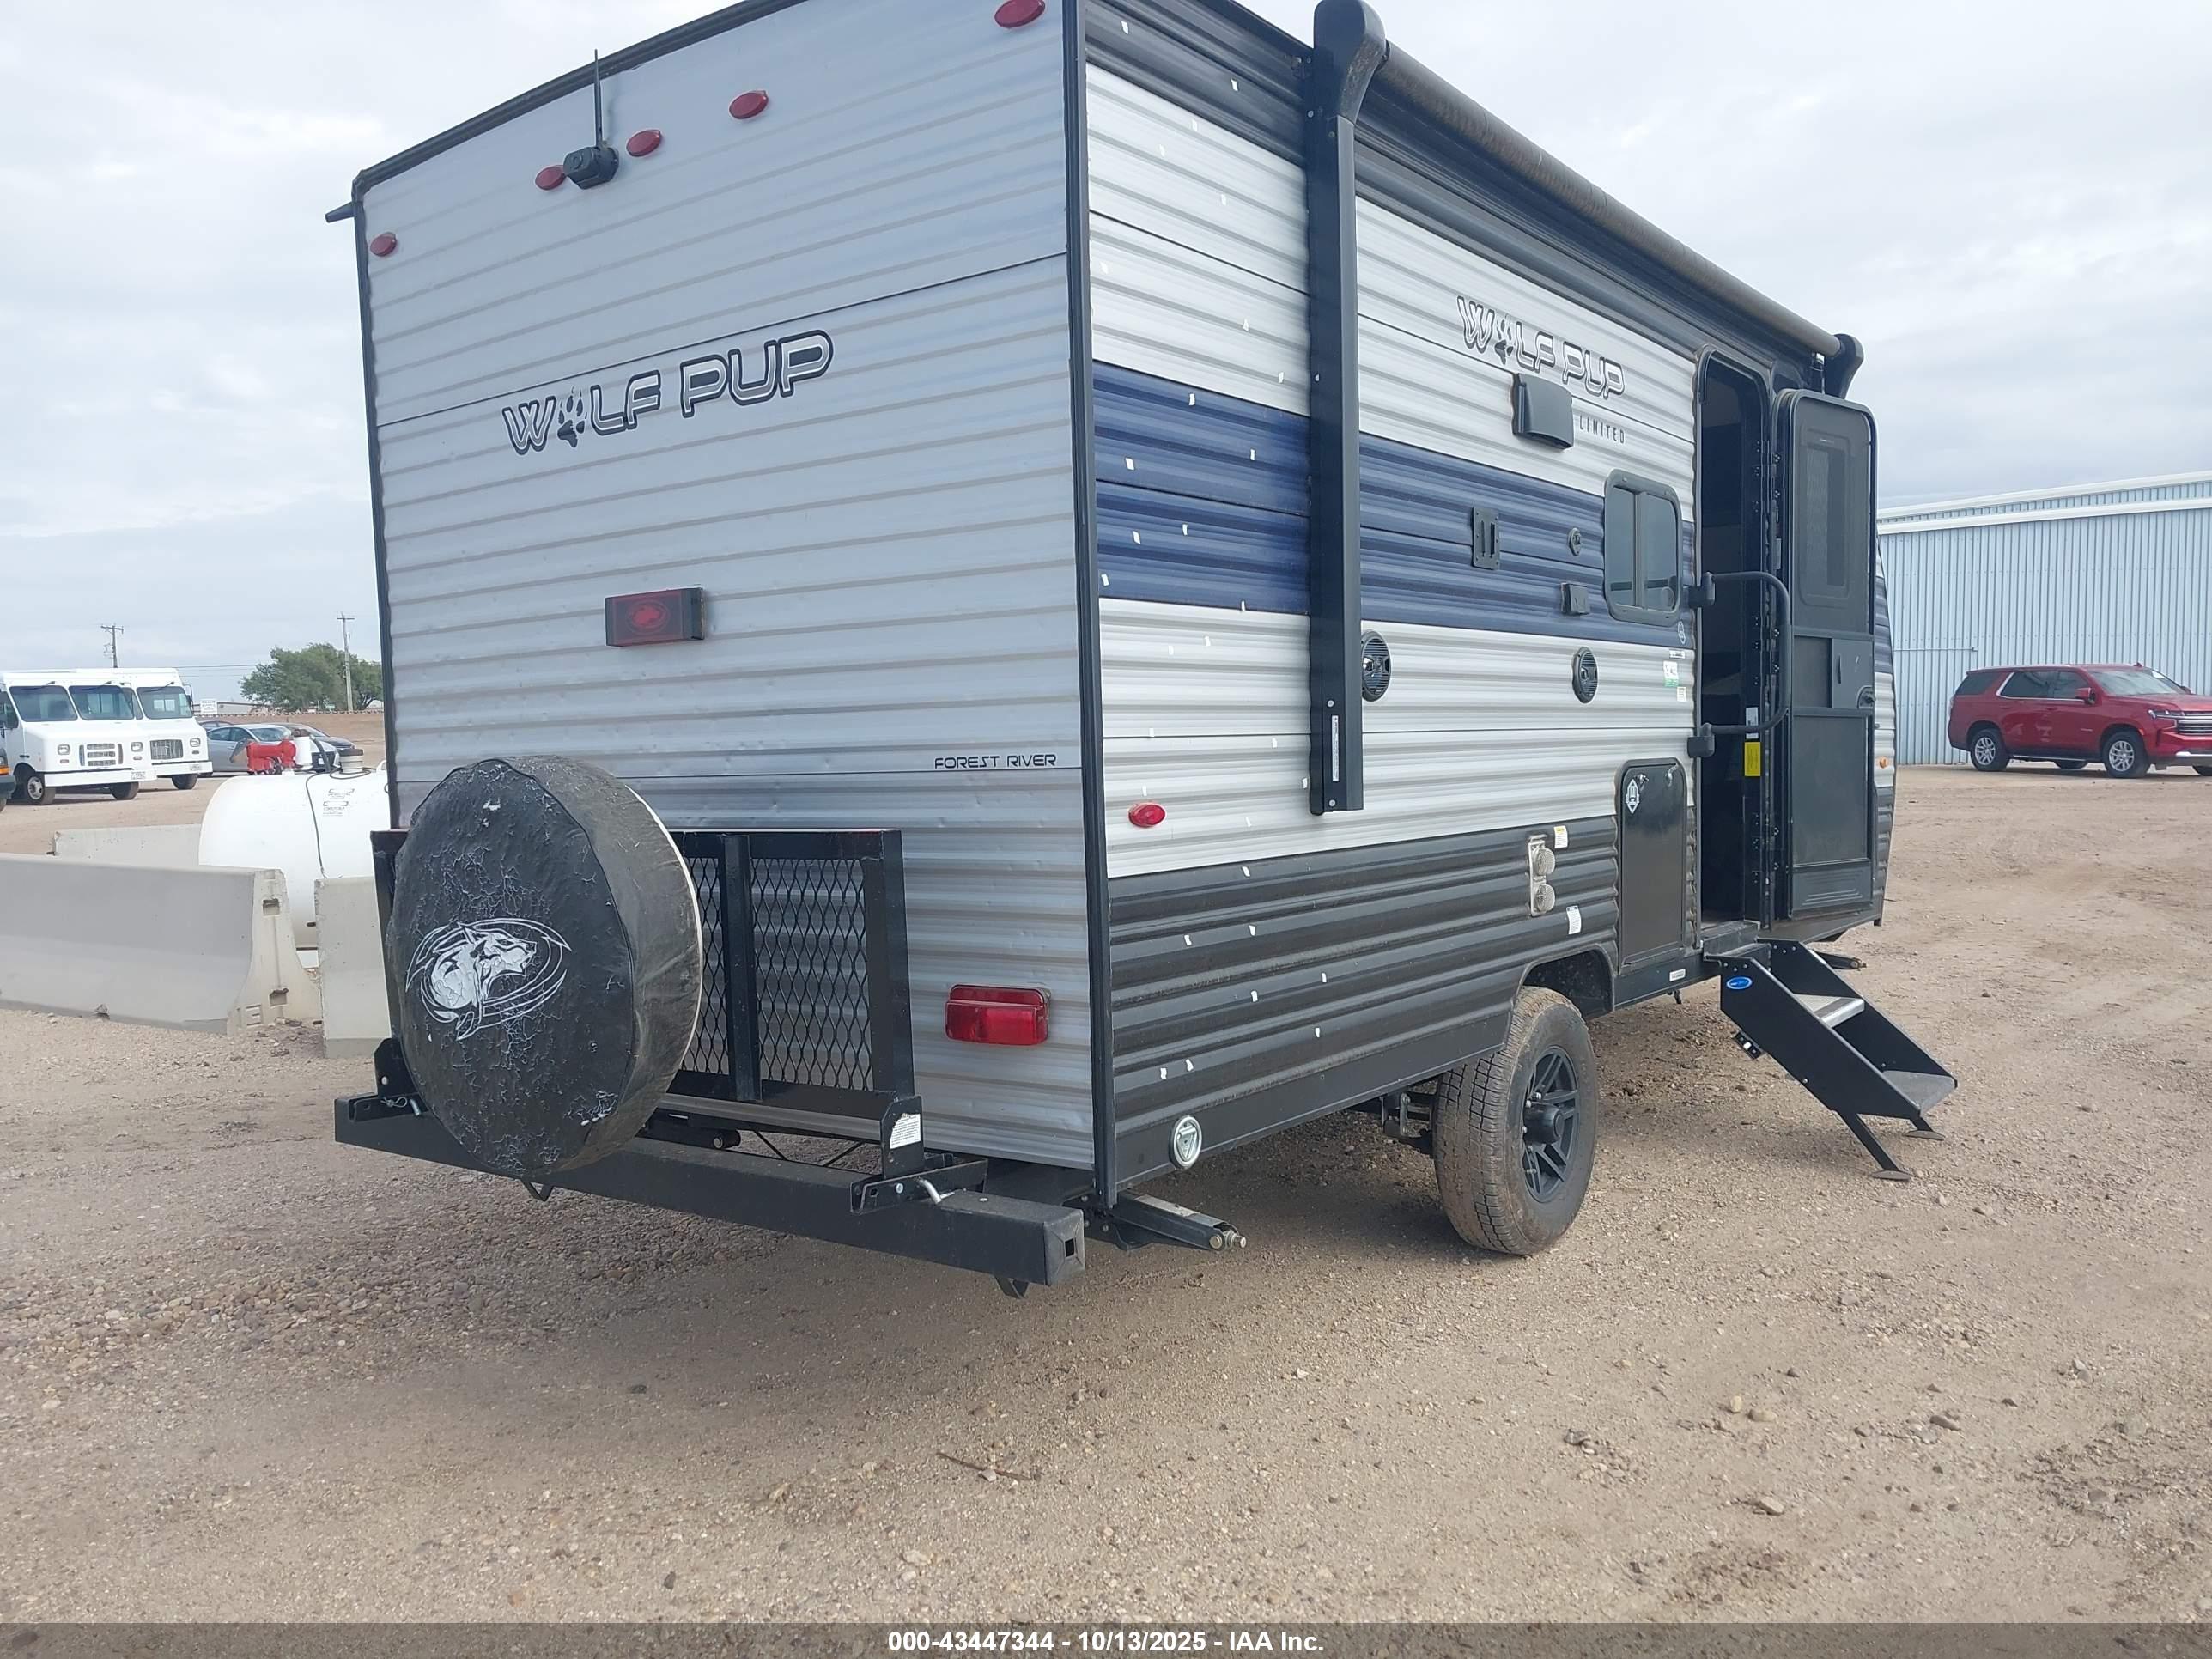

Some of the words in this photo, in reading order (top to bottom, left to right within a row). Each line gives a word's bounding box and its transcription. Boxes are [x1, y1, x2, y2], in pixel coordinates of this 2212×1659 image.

[1456, 295, 1556, 374] WLF
[1562, 340, 1626, 400] PUP
[501, 369, 660, 456] WLF
[679, 329, 834, 418] PUP
[1579, 415, 1625, 444] LIMITED
[934, 756, 1000, 769] FOREST
[1006, 754, 1057, 768] RIVER
